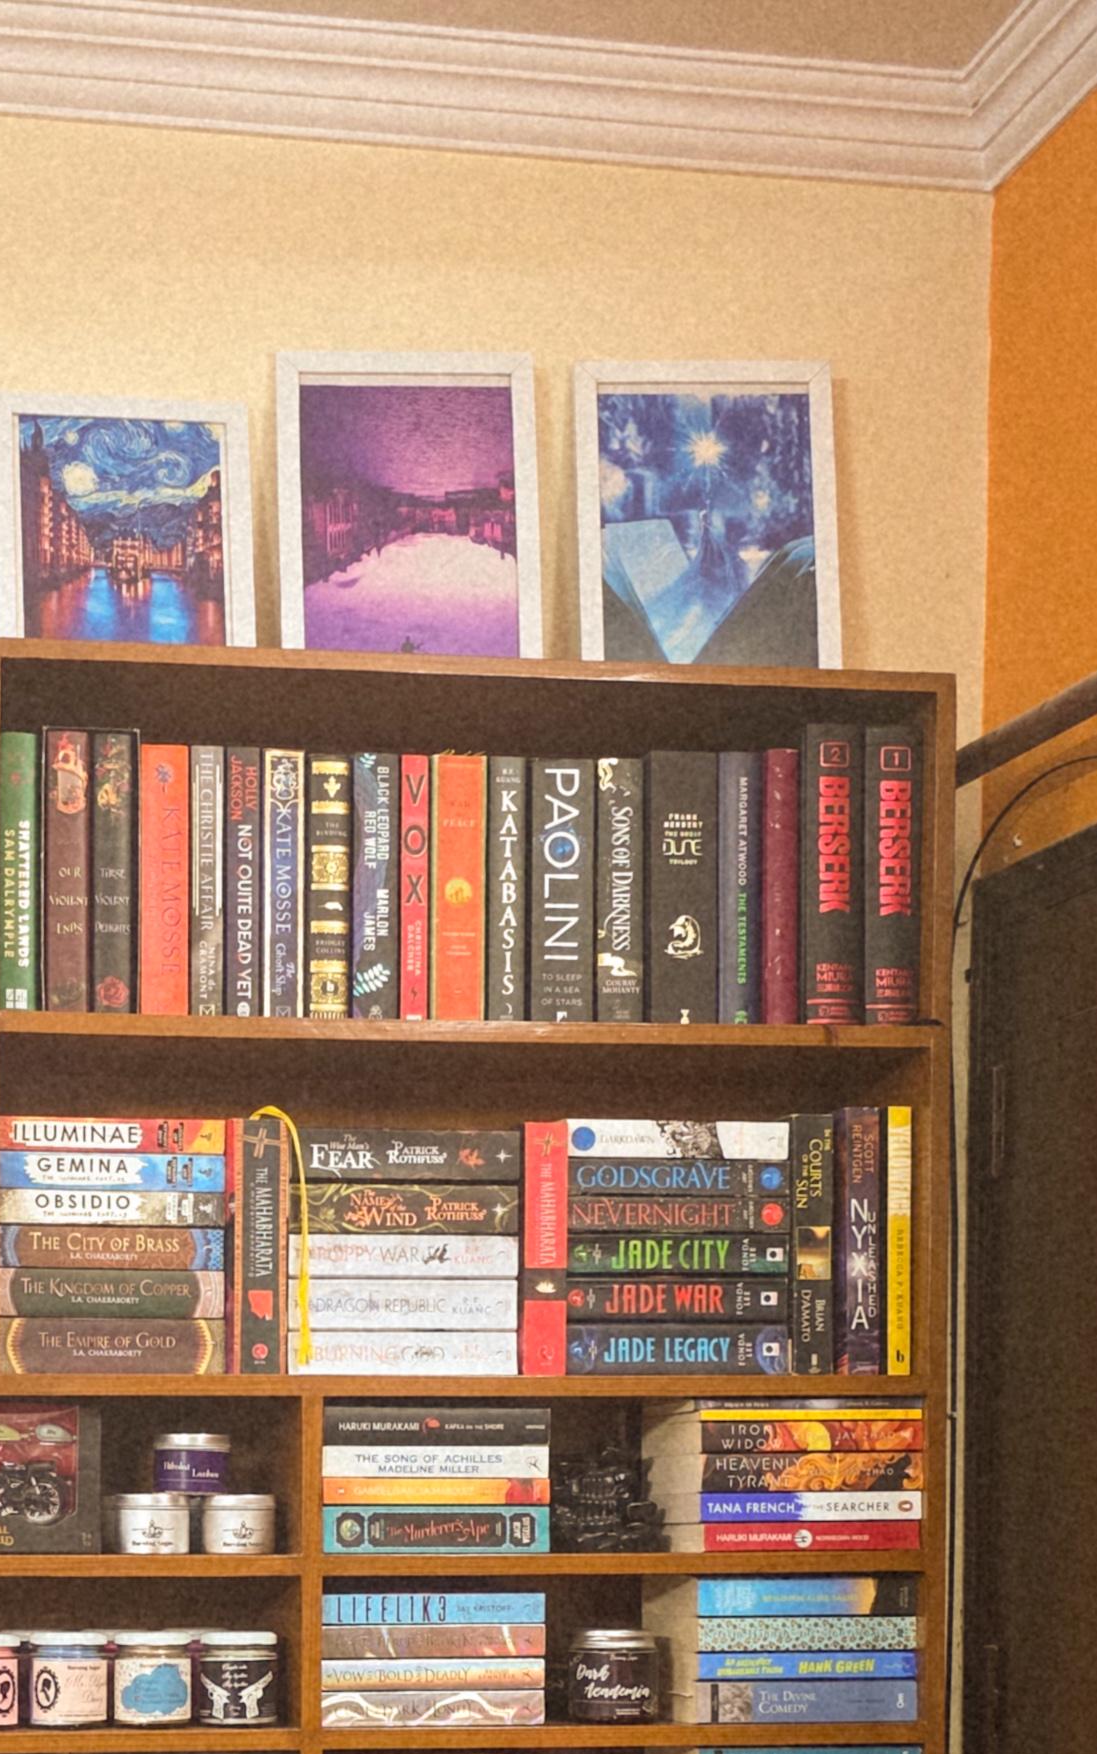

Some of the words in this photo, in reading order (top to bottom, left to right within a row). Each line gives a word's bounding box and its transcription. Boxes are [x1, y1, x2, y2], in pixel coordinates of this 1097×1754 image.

[229, 755, 243, 821] JACKSON
[243, 766, 259, 813] HOLLY
[739, 777, 748, 838] MARGARET
[4, 829, 15, 856] SAM
[237, 824, 253, 860] NOT
[275, 805, 292, 858] KATE
[405, 774, 426, 905] VOX
[819, 776, 850, 913] BERSERK
[879, 780, 911, 916] BERSERK
[17, 820, 30, 908] SHATTERED
[543, 768, 580, 961] PAOLINI
[738, 841, 748, 886] ATWOOD
[4, 861, 15, 958] DALRYMPLE
[237, 865, 253, 913] QUITE
[274, 864, 292, 935] MOSSE
[499, 790, 519, 994] KATABASIS
[738, 892, 747, 912] THE
[18, 912, 29, 968] LANDS
[237, 917, 253, 963] DEAD
[738, 916, 747, 984] TESTAMENTS
[237, 966, 253, 1000] YET
[12, 1122, 139, 1143] ILLUMINAE
[37, 1157, 129, 1174] GEMINA
[577, 1161, 730, 1189] GODSGRAVE
[34, 1194, 129, 1210] OBSIDIO
[572, 1205, 734, 1227] NEVERNIGHT
[612, 1240, 672, 1270] JADE
[679, 1240, 729, 1269] CITY
[851, 1198, 869, 1329] NYXIA
[606, 1286, 667, 1313] JADE
[674, 1286, 723, 1313] WAR
[604, 1337, 658, 1362] JADE
[665, 1336, 730, 1362] LEGACY
[338, 1422, 371, 1431] HARUKI
[373, 1422, 419, 1431] MURAKAMI
[356, 1455, 377, 1464] THE
[384, 1454, 417, 1464] SONG
[423, 1455, 439, 1464] OF
[444, 1454, 502, 1464] ACHILLES
[379, 1465, 434, 1474] MADELINE
[440, 1465, 479, 1473] MILLER
[707, 1503, 742, 1513] TANA
[746, 1502, 795, 1513] FRENCH
[825, 1502, 890, 1512] SEARCHER
